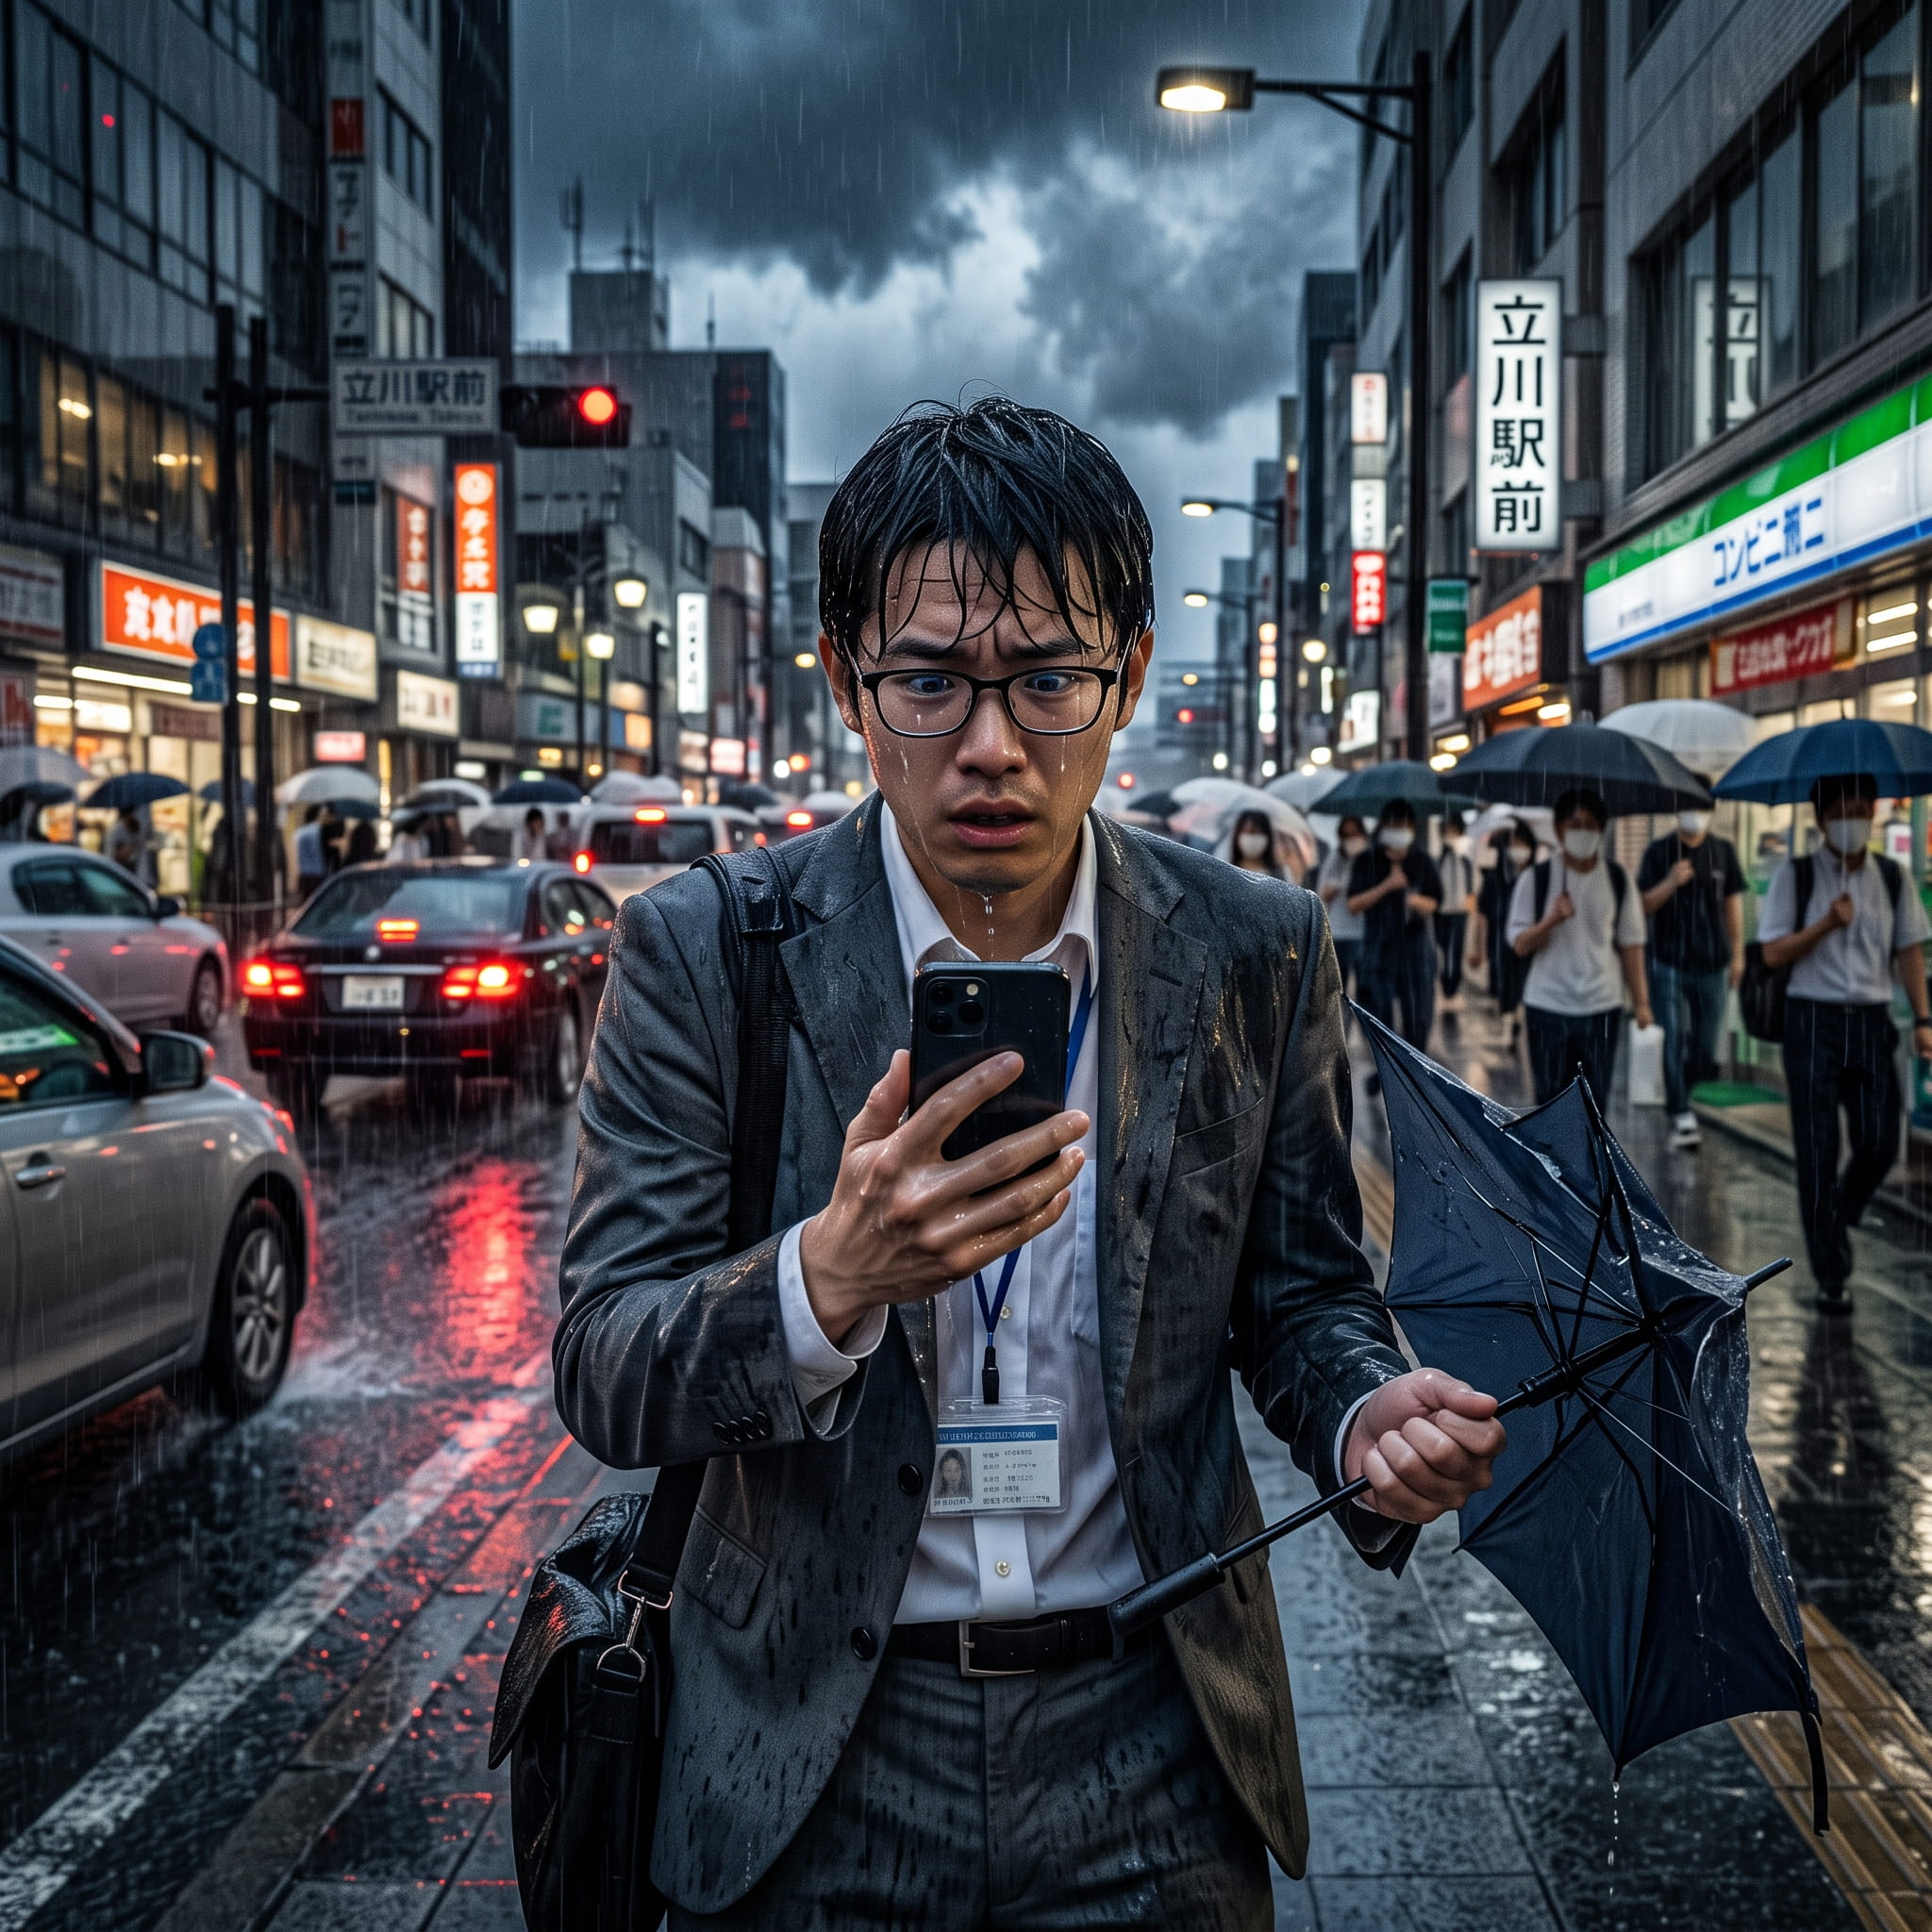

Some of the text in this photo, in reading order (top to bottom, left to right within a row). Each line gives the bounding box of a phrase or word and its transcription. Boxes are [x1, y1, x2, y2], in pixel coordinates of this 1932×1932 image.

[341, 369, 486, 406] 立川駅前
[1491, 295, 1546, 533] 立川駅前
